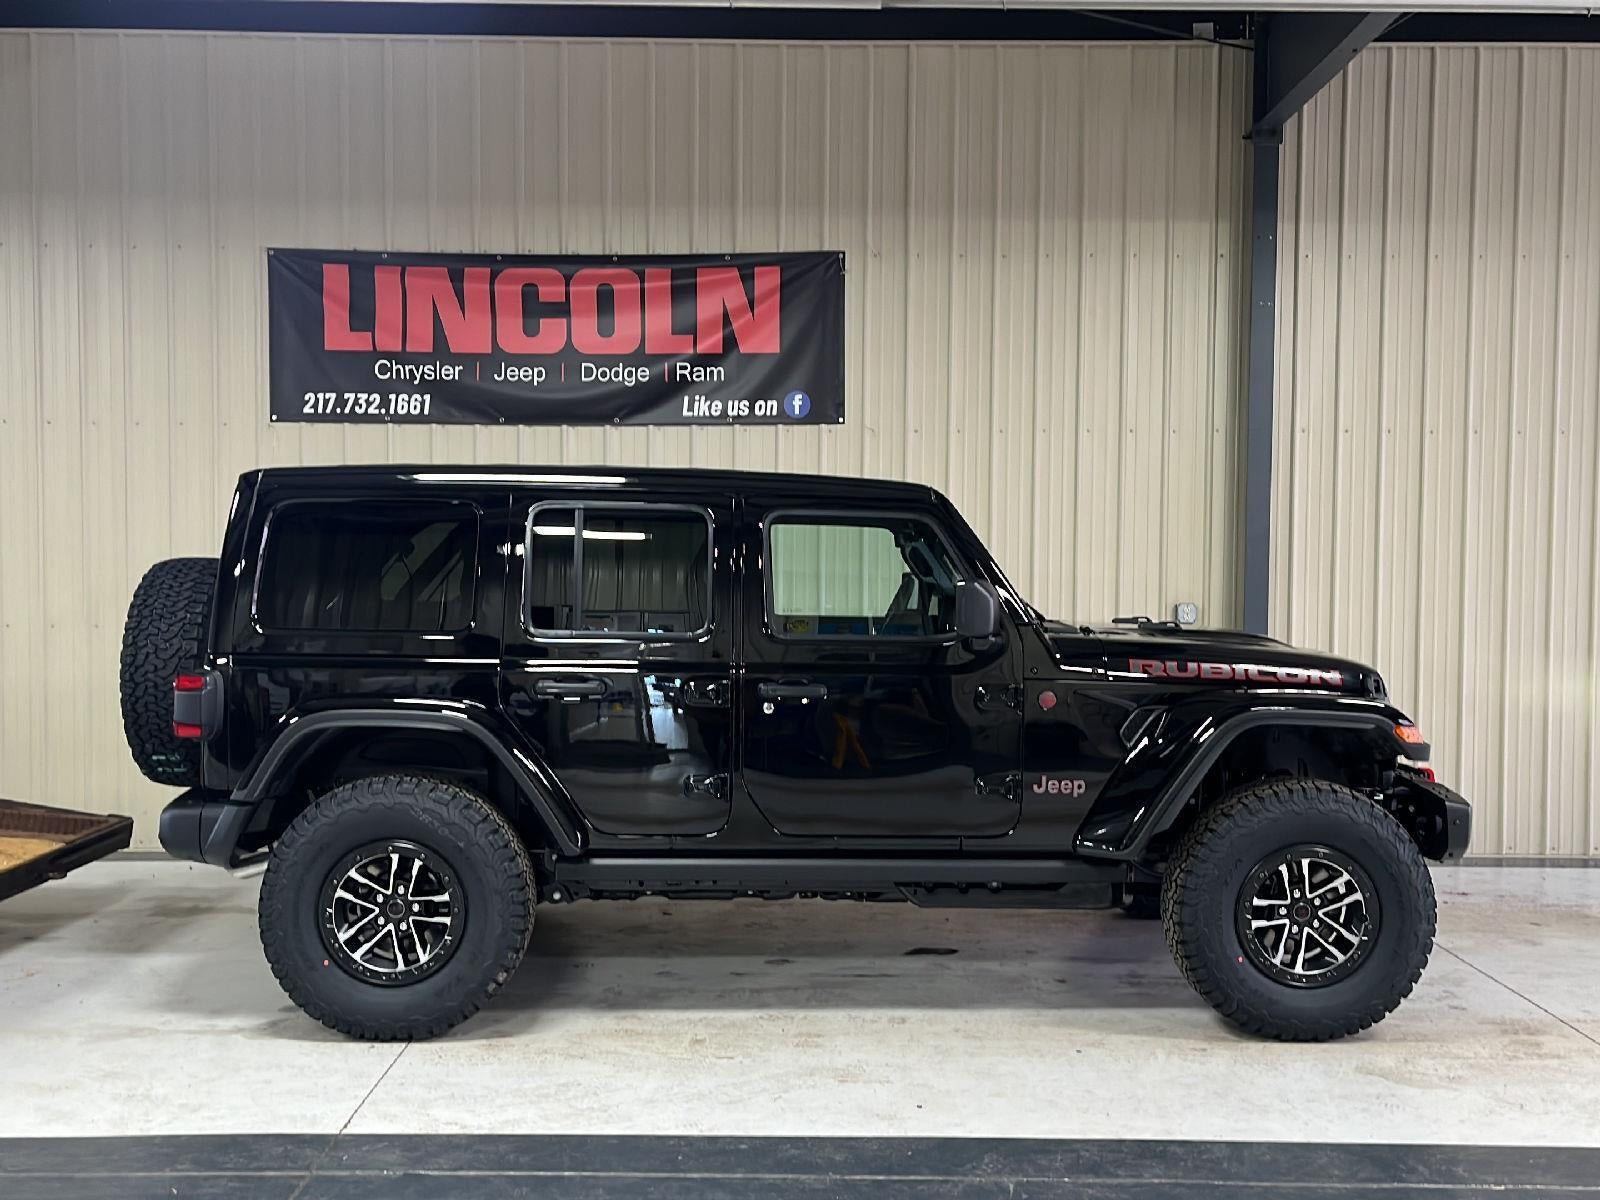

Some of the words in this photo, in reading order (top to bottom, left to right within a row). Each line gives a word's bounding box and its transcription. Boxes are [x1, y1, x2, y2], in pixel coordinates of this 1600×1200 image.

[323, 264, 780, 354] LINCOLN
[374, 359, 463, 383] Chrysler
[493, 362, 546, 384] Jeep
[581, 362, 650, 386] Dodge
[676, 363, 725, 382] Ram
[303, 392, 431, 415] 217.732.1661
[682, 395, 722, 417] Like
[727, 399, 750, 416] us
[755, 398, 778, 416] on
[1129, 658, 1342, 685] RUBICON
[1032, 775, 1086, 797] Jeep
